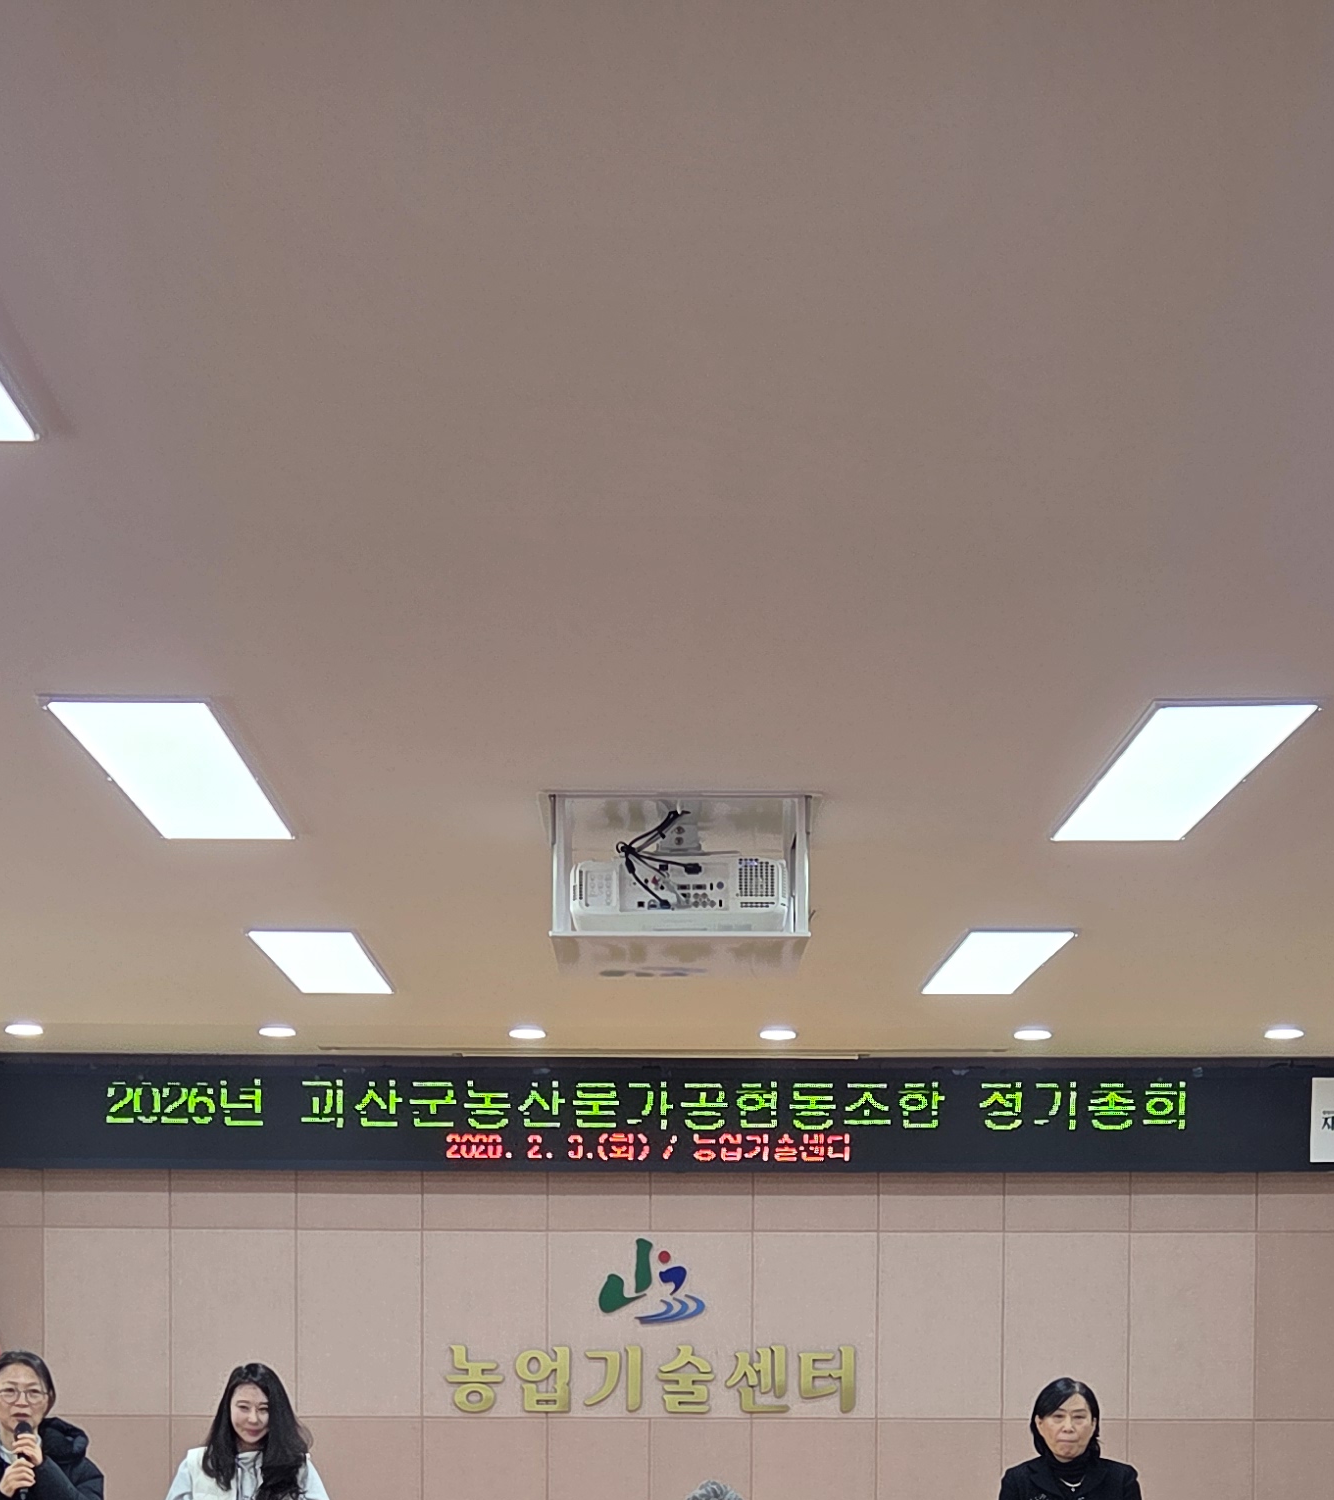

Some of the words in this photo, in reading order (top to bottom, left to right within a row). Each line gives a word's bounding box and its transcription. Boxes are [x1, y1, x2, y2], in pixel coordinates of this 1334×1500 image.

[105, 1078, 264, 1127] 2026년
[978, 1081, 1187, 1131] 정기총회
[445, 1345, 856, 1414] 농업기술센터
